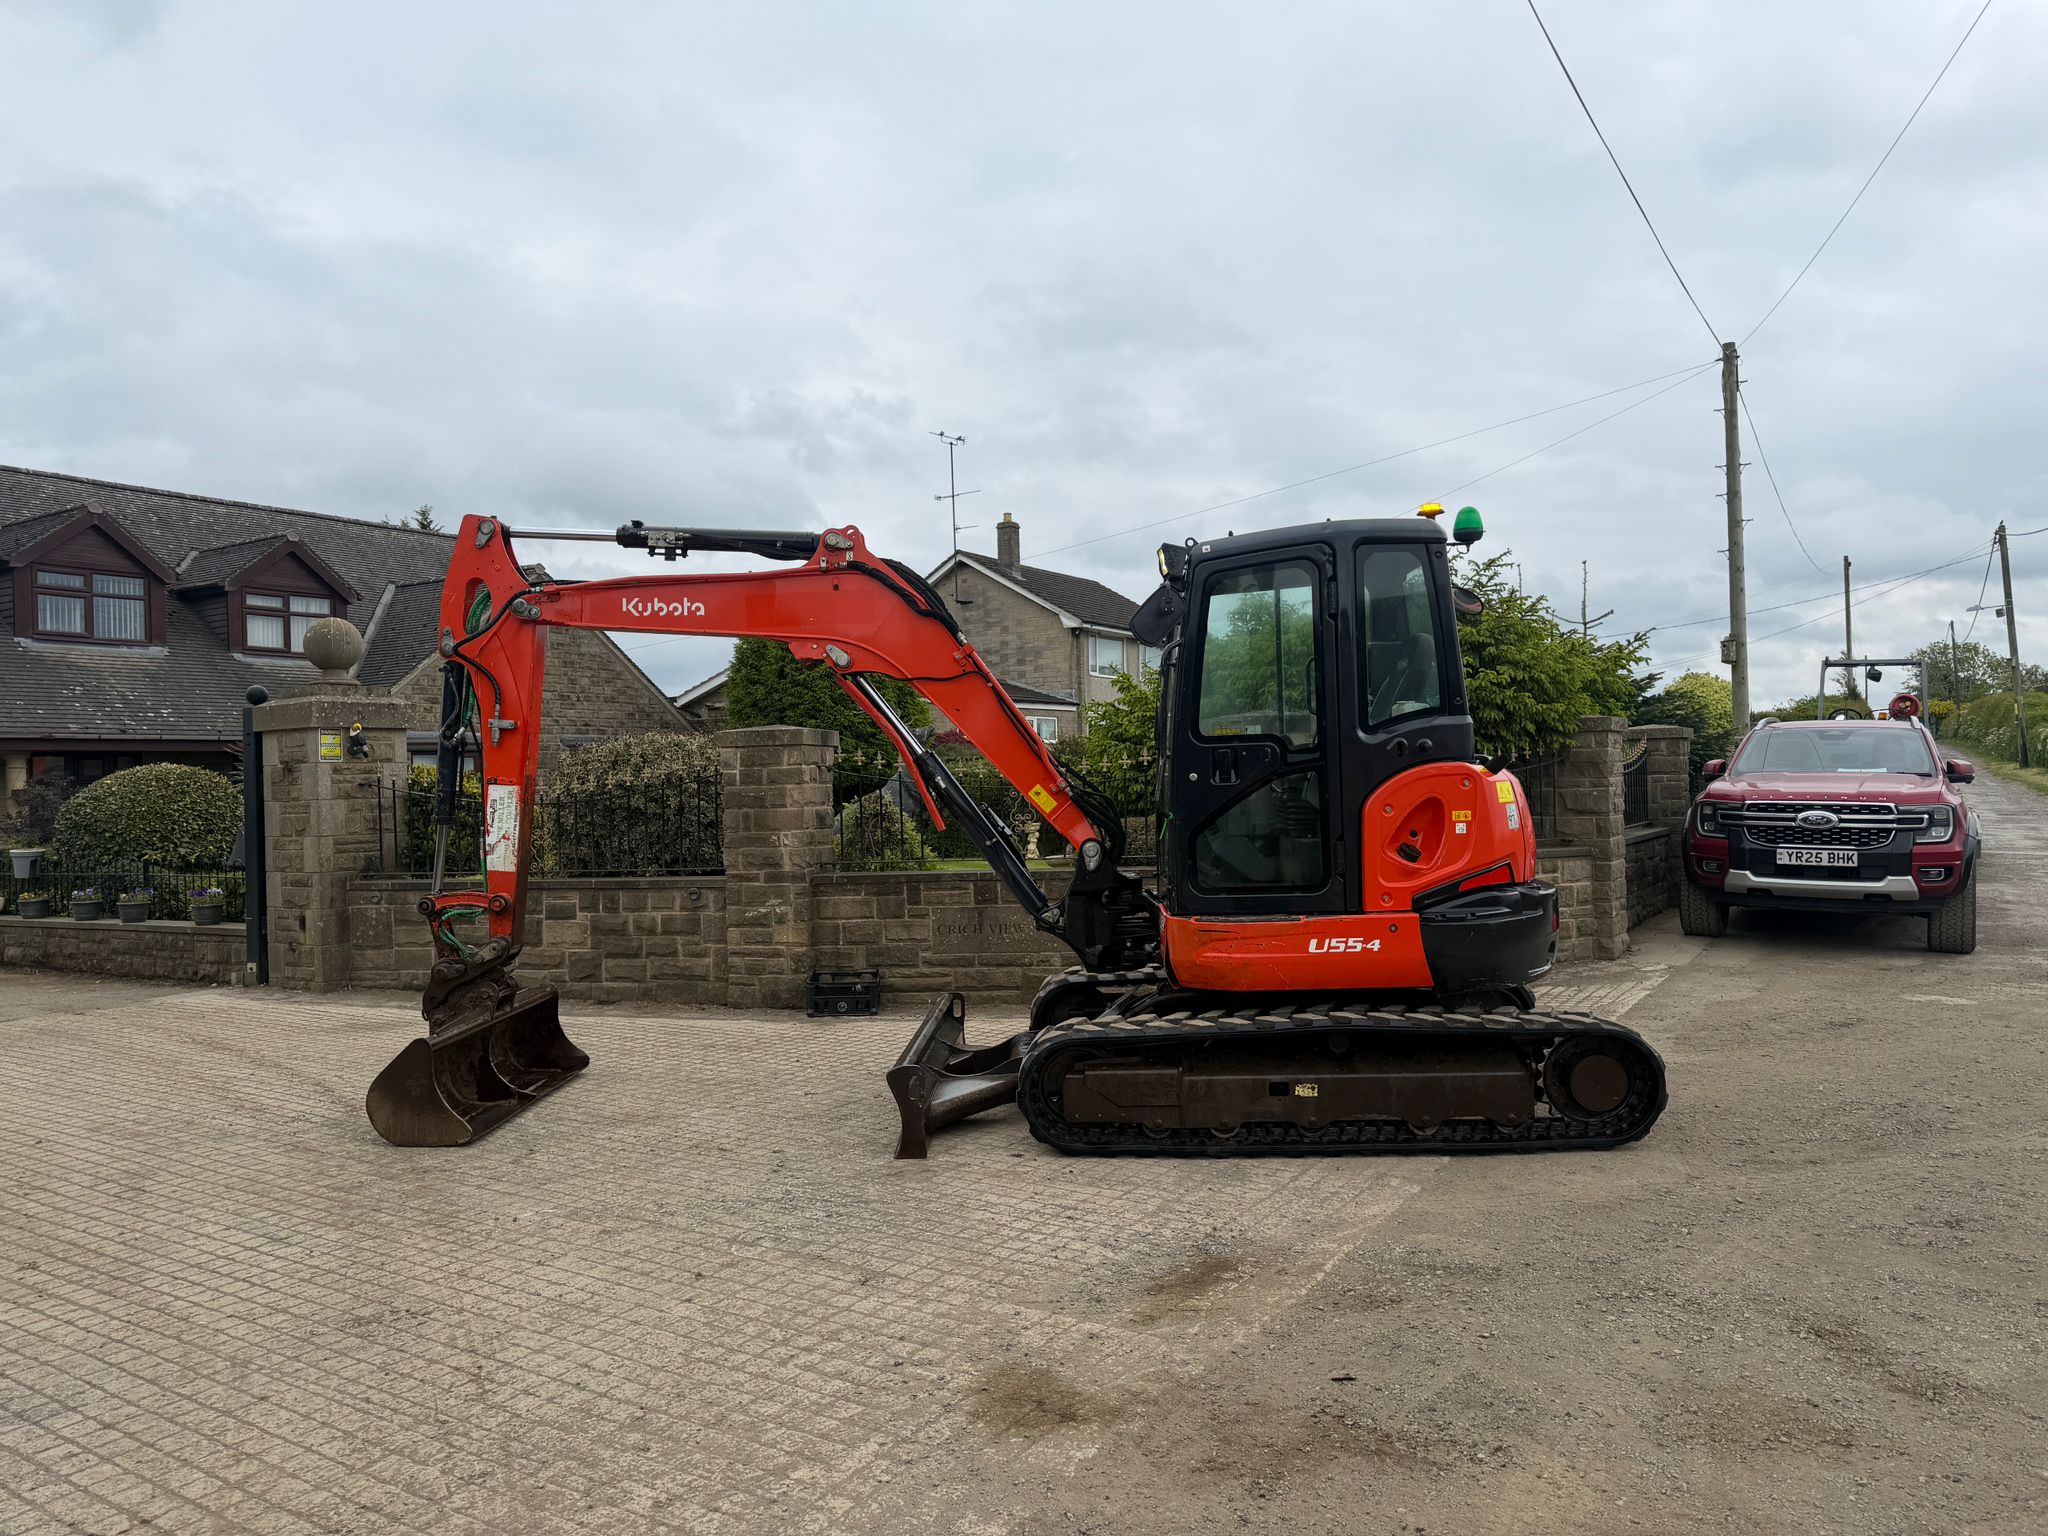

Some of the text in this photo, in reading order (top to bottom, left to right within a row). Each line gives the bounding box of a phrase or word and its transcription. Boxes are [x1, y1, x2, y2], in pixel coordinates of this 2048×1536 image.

[622, 597, 705, 617] Kubota
[1806, 815, 1828, 825] Ford
[1786, 851, 1856, 866] YR25 BHK
[937, 923, 983, 935] CRICH
